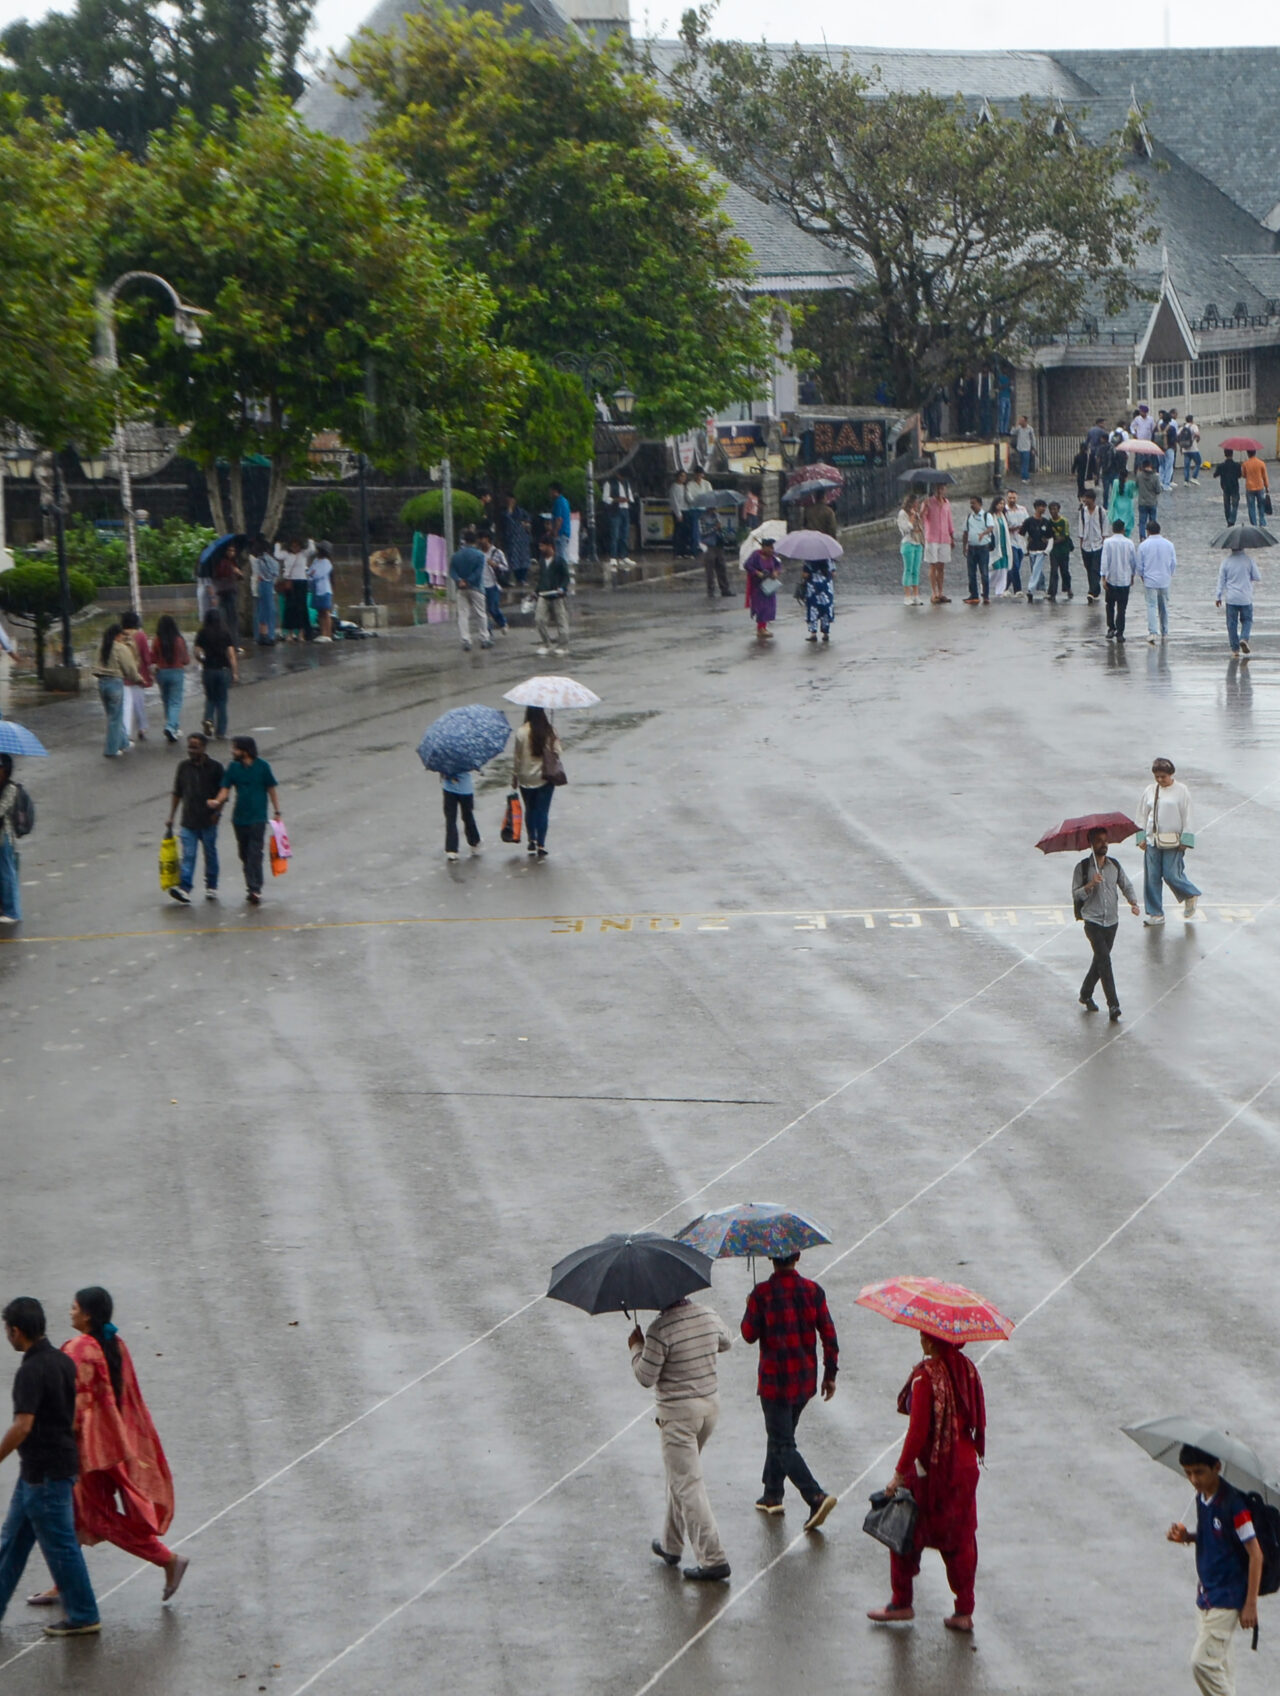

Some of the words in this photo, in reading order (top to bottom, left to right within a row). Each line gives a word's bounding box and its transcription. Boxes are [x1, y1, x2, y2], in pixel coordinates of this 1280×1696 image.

[815, 422, 883, 453] BAR
[550, 916, 730, 933] ZONE
[793, 909, 1068, 930] EHICLE
